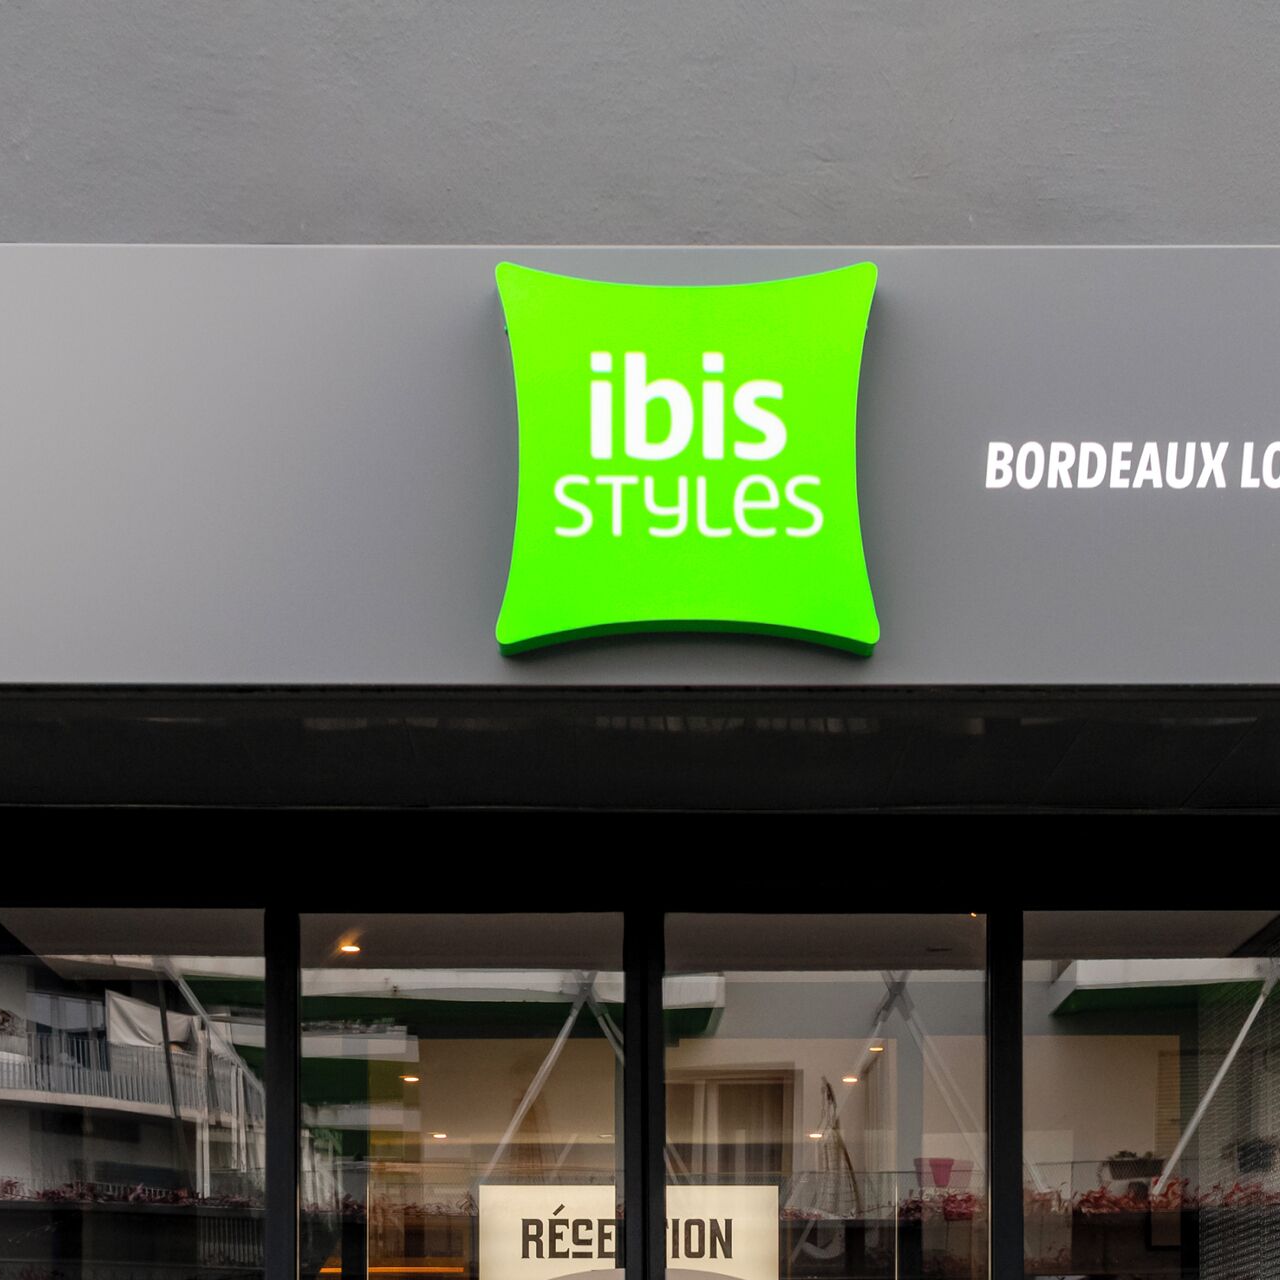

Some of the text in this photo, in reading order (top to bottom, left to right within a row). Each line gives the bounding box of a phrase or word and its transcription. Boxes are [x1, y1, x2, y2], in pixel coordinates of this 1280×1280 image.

[590, 352, 787, 461] ibis
[985, 440, 1229, 490] BORDEAUX
[521, 1204, 733, 1259] RÉCEION
